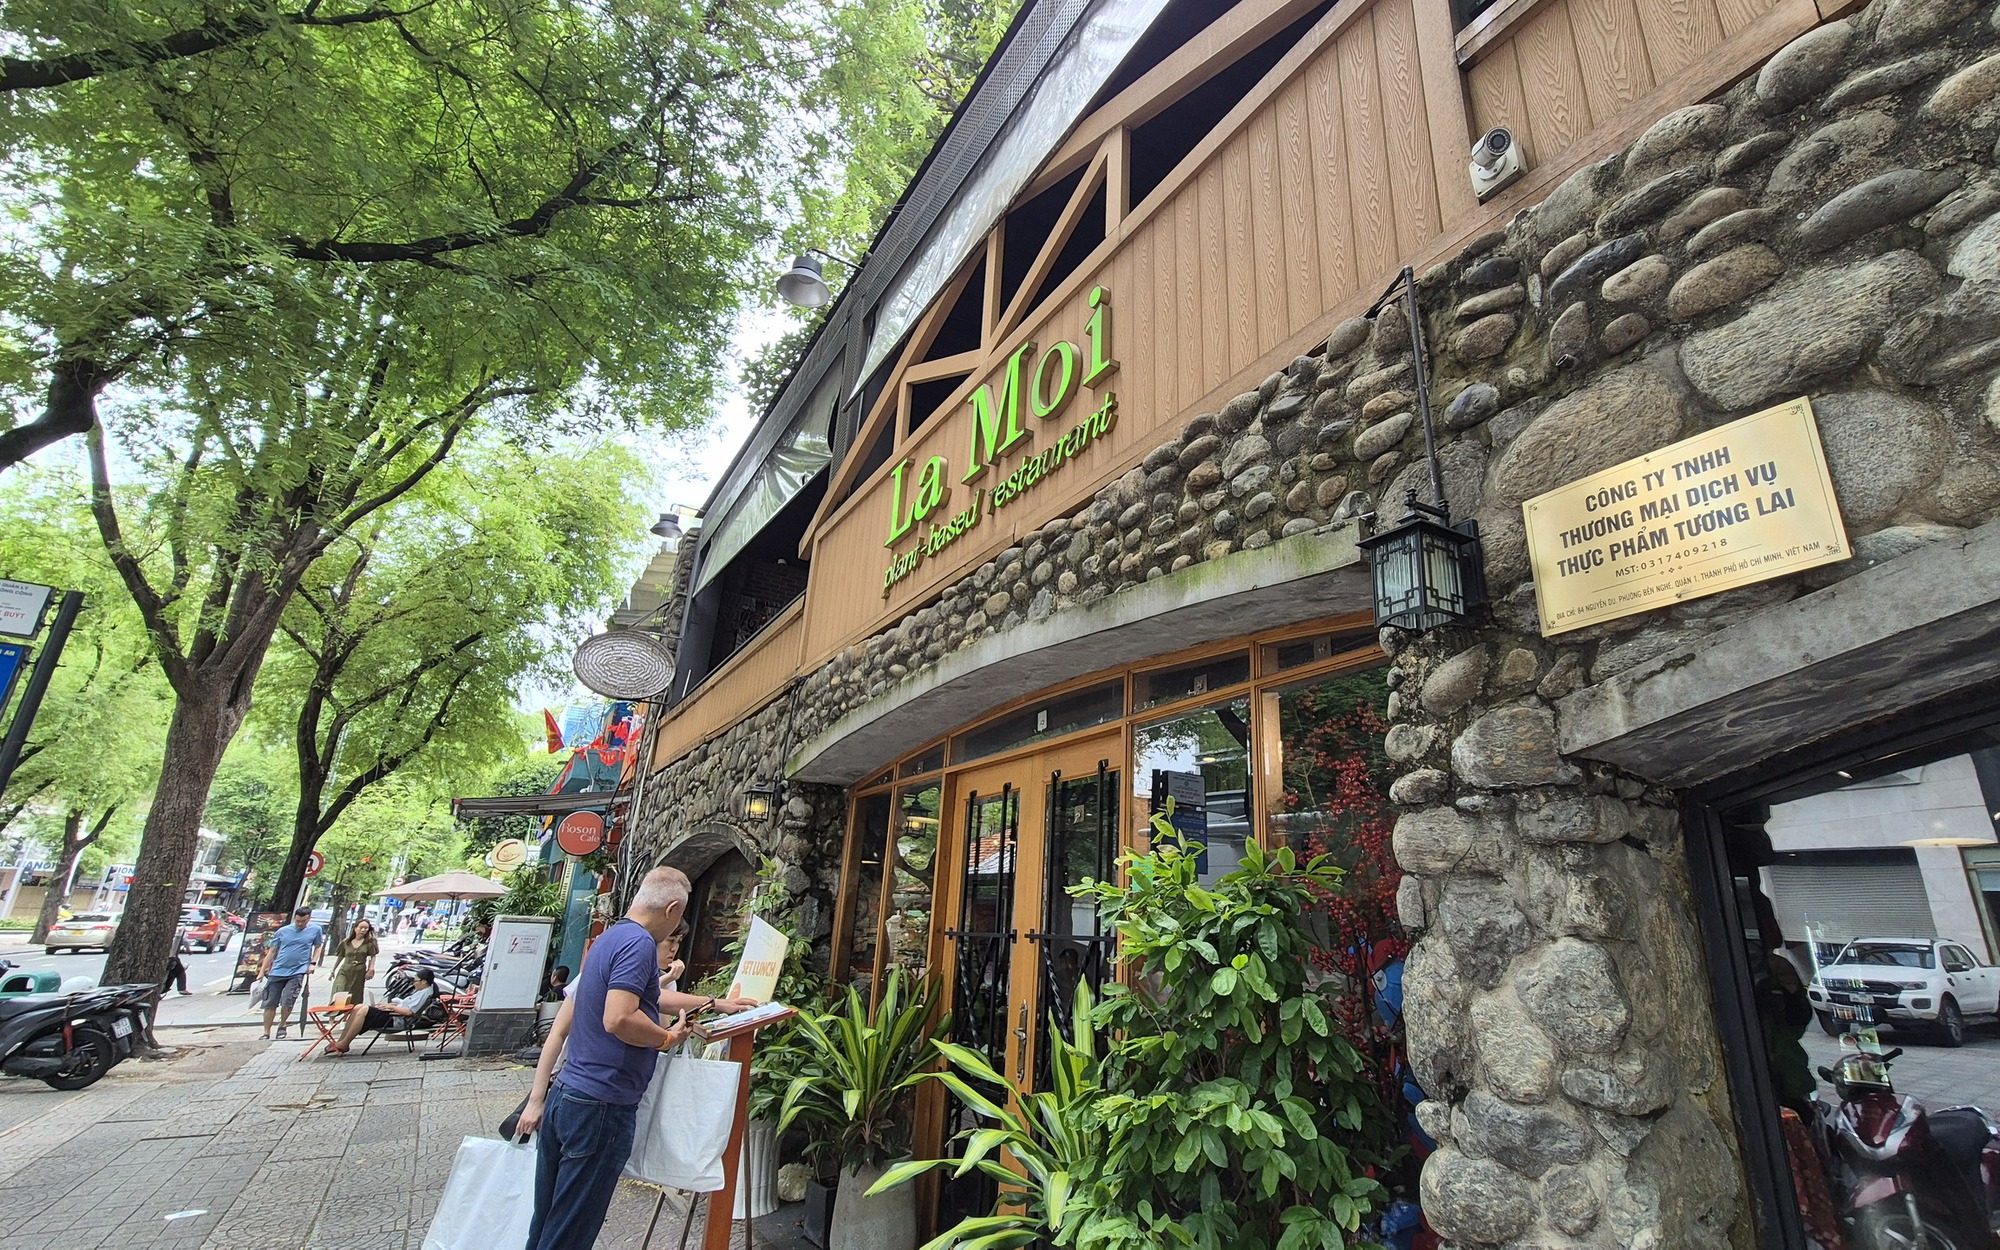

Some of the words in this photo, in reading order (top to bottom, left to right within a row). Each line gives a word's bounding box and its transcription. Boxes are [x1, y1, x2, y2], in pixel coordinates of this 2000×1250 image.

[884, 455, 949, 548] La
[961, 285, 1120, 486] Moi
[882, 488, 985, 596] plant-based
[988, 392, 1118, 514] restaurant
[1560, 510, 1634, 548] THƯƠNG
[1639, 494, 1680, 522] MẠI
[1685, 473, 1740, 507] DỊCH
[1744, 461, 1777, 486] VỤ
[1585, 480, 1638, 512] CÔNG
[1642, 469, 1665, 491] TY
[1672, 446, 1732, 481] TNHH
[1557, 548, 1604, 577] THỰC
[1609, 526, 1669, 561] PHẨM
[1674, 502, 1750, 541] TƯƠNG
[1755, 487, 1795, 516] LAI
[1803, 541, 1820, 553] NAM
